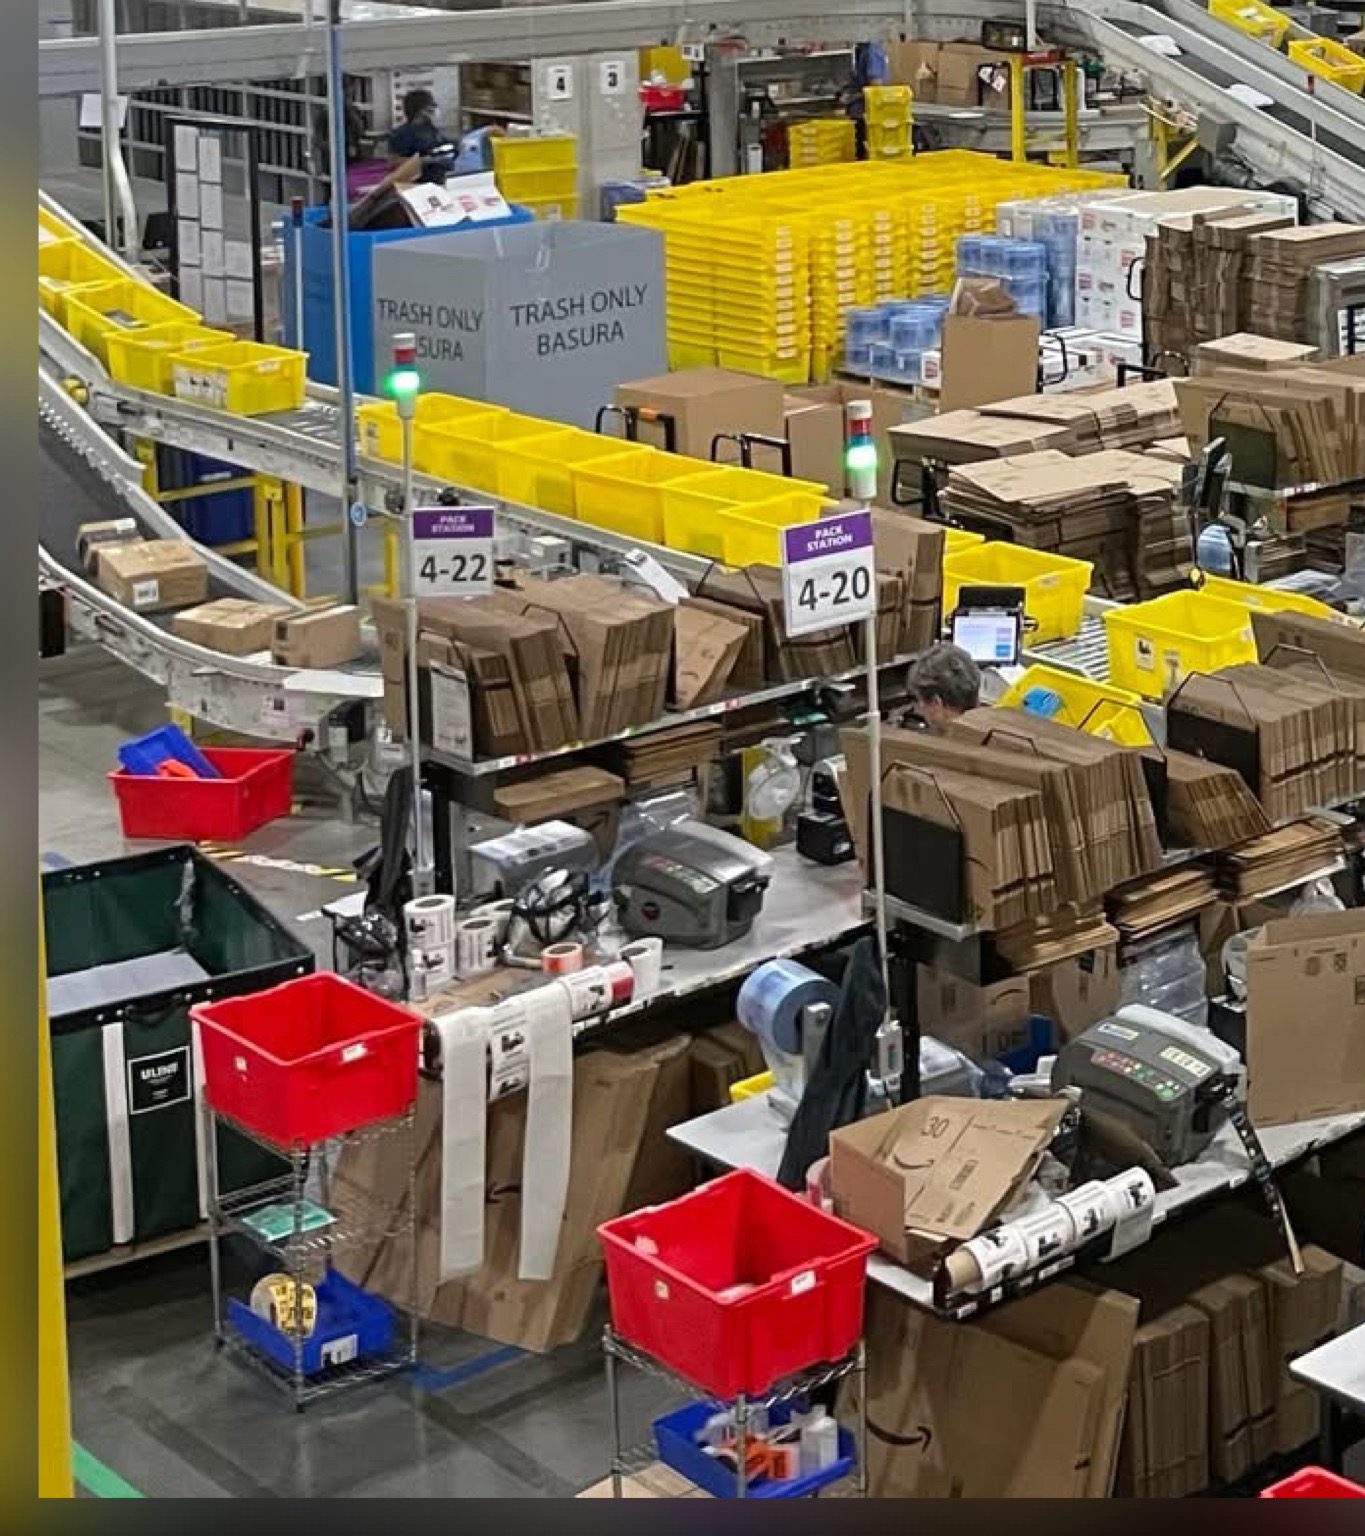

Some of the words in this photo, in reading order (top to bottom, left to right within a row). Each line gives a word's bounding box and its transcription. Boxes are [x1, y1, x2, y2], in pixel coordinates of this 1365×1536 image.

[377, 298, 433, 326] TRASH
[438, 306, 483, 333] ONLY
[509, 296, 585, 327] TRASH
[591, 283, 648, 313] ONLY
[416, 335, 464, 361] SURA
[537, 320, 624, 356] BASURA
[807, 533, 853, 552] STATION
[814, 524, 843, 539] PACK
[420, 552, 487, 583] 4-22
[798, 566, 870, 612] 4-20
[919, 1115, 950, 1139] 30
